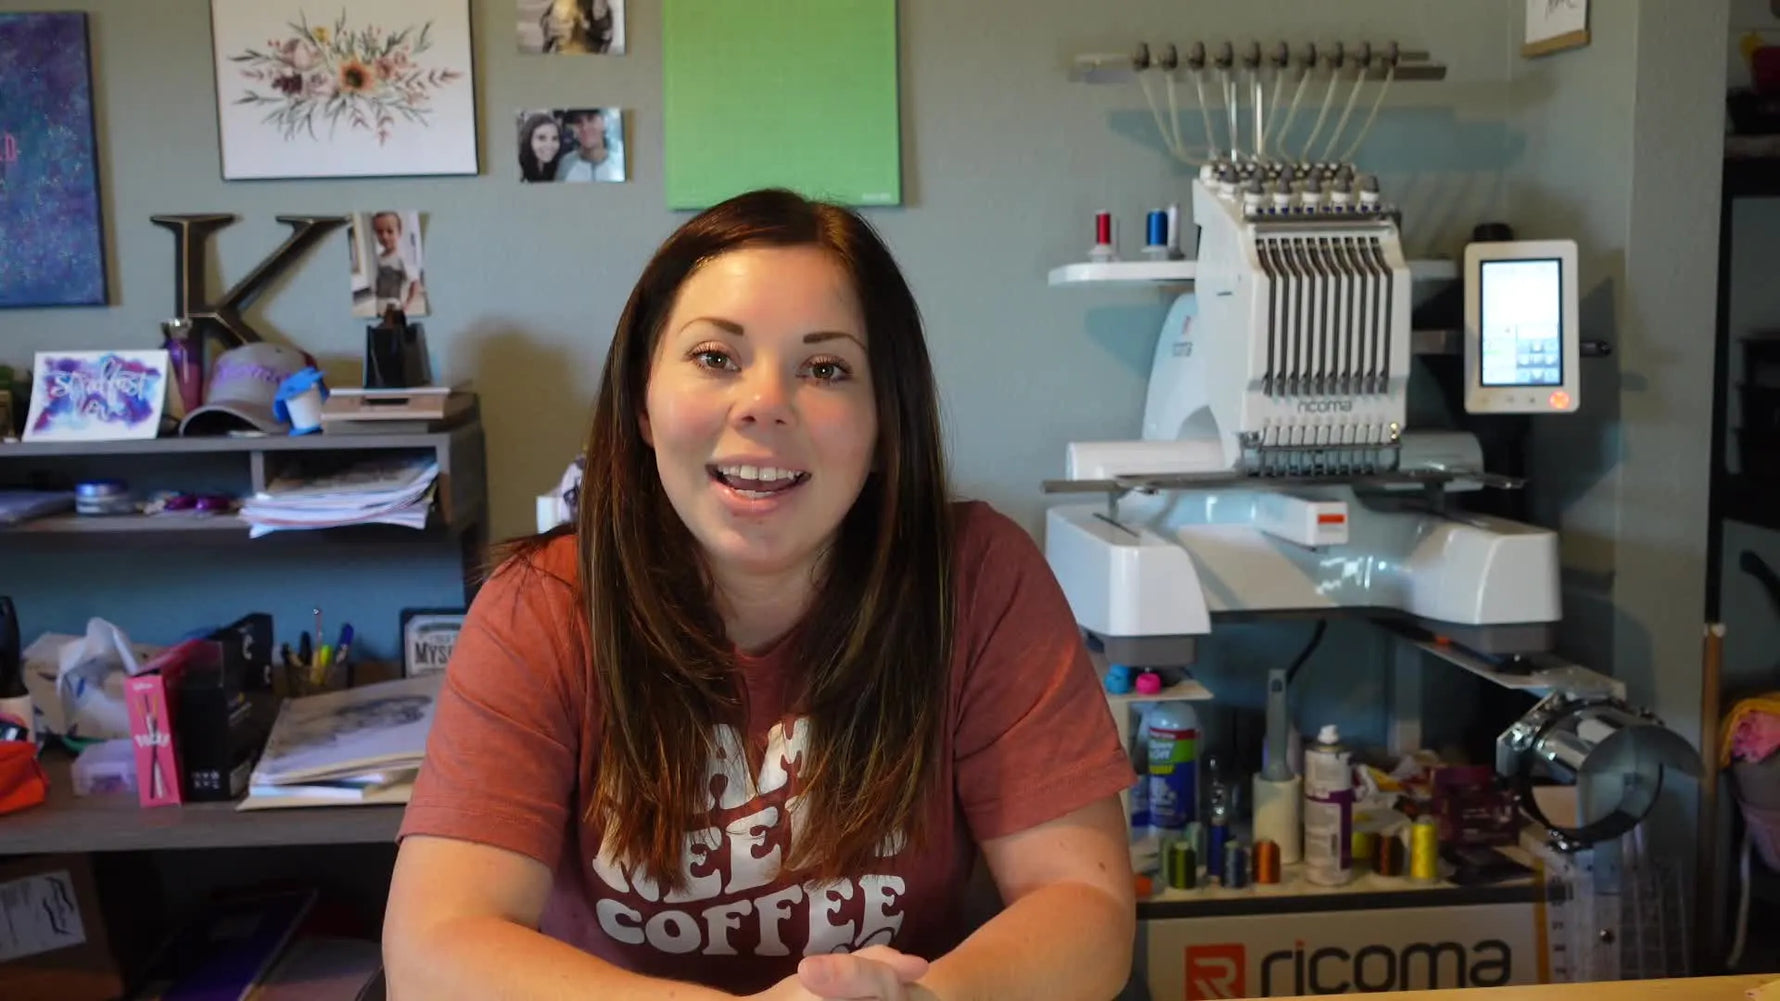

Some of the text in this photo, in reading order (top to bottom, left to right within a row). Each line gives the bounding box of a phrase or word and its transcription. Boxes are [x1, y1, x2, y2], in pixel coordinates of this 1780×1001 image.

[151, 213, 350, 346] K
[596, 874, 906, 957] COFFEE
[1261, 939, 1513, 997] ricoma
